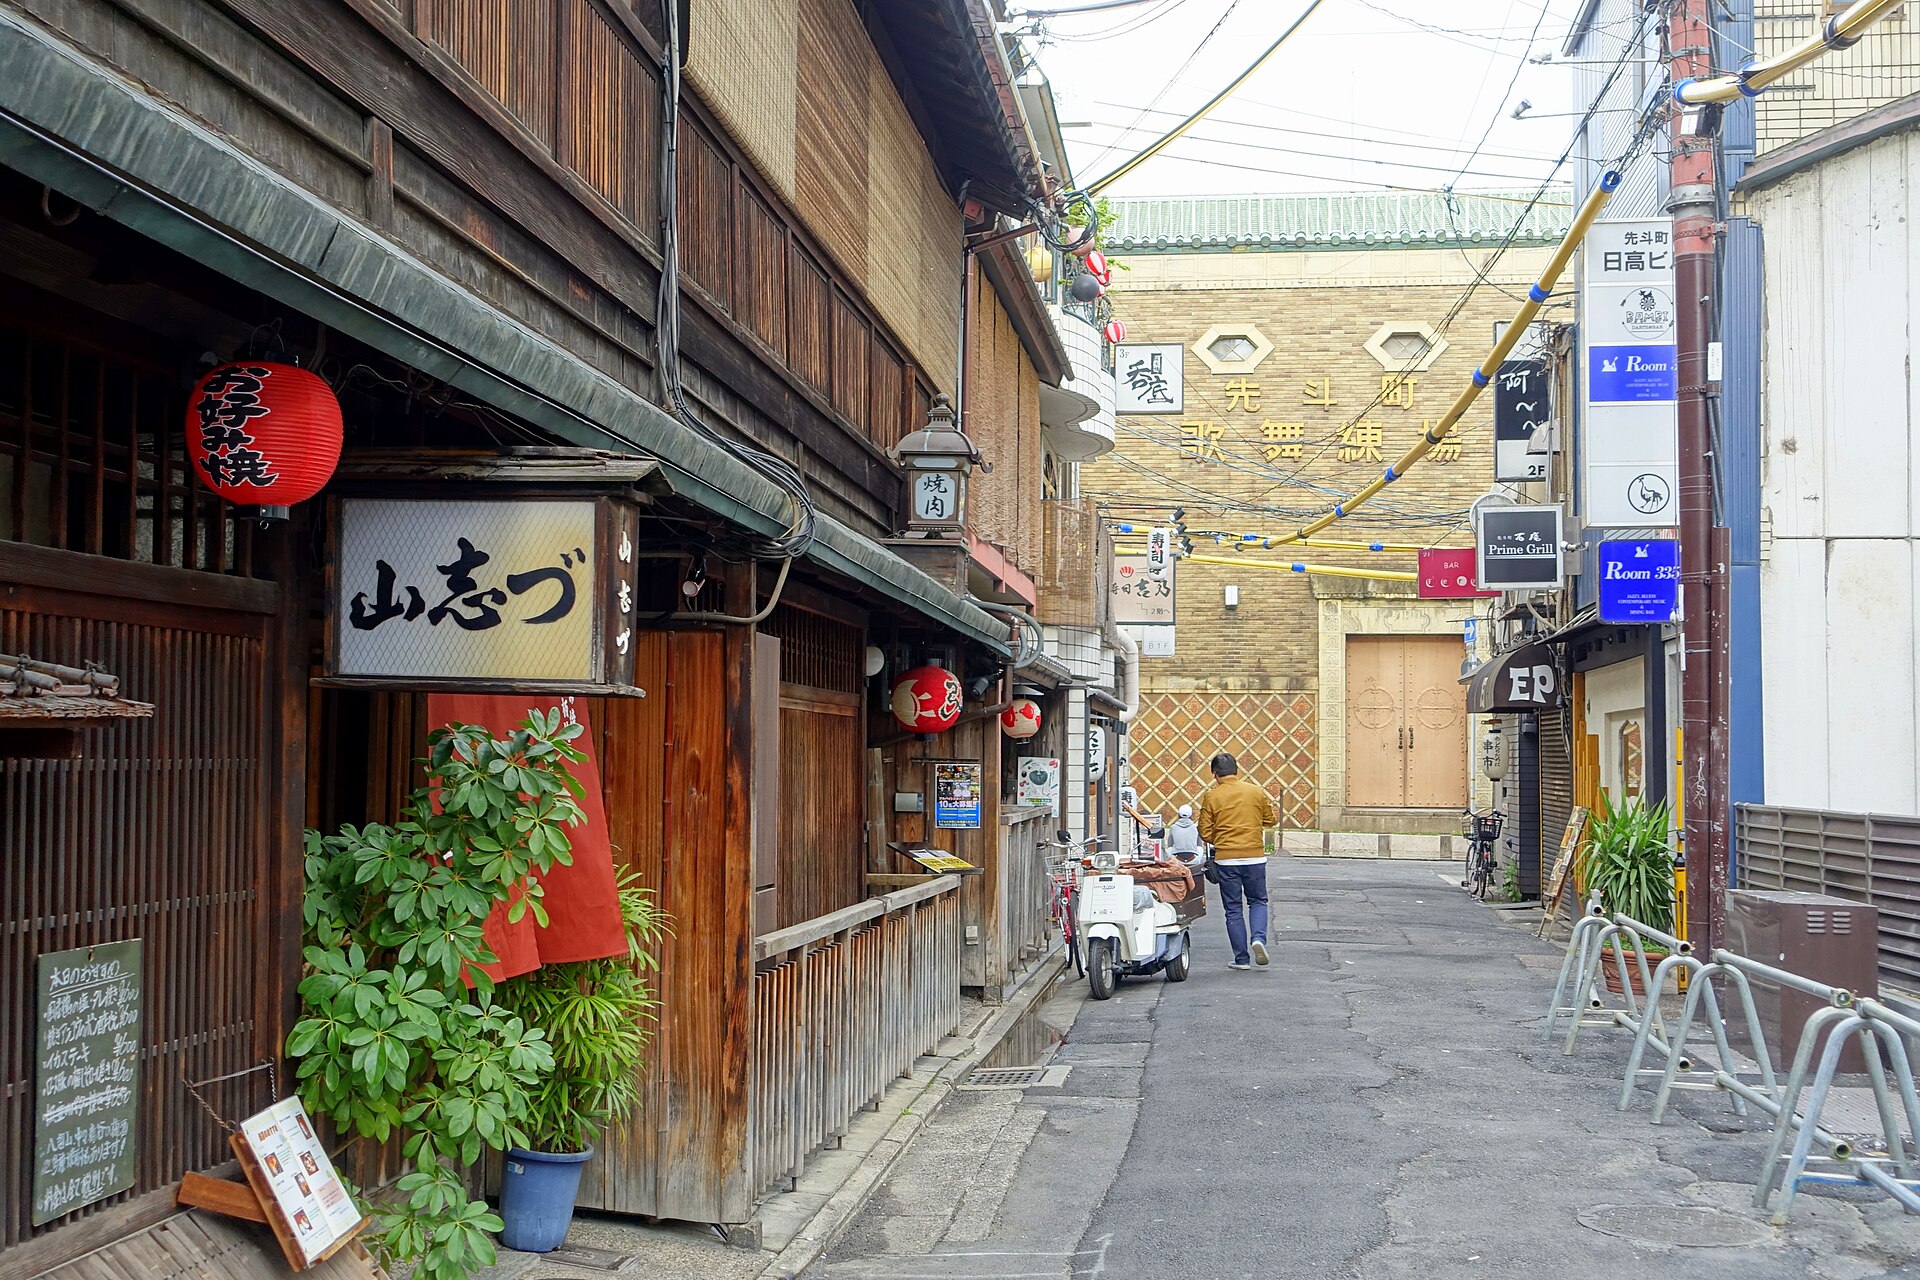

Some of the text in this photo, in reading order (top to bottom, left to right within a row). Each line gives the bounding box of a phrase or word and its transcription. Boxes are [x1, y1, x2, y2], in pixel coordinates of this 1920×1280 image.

[1624, 231, 1669, 245] 先斗町
[1604, 251, 1674, 272] 日高ビ
[1119, 348, 1130, 358] 3F
[1625, 355, 1667, 372] Room
[1225, 376, 1418, 412] 先斗町
[197, 366, 280, 488] お好み焼
[1180, 418, 1462, 464] 歌舞練場
[1528, 465, 1545, 476] 2F
[924, 474, 948, 518] 焼肉
[1151, 532, 1164, 564] 寿司
[1488, 543, 1553, 555] Prime Grill
[350, 537, 586, 631] 山志づ
[1604, 561, 1650, 580] Room
[1508, 664, 1555, 704] EP
[1482, 739, 1494, 771] 串市
